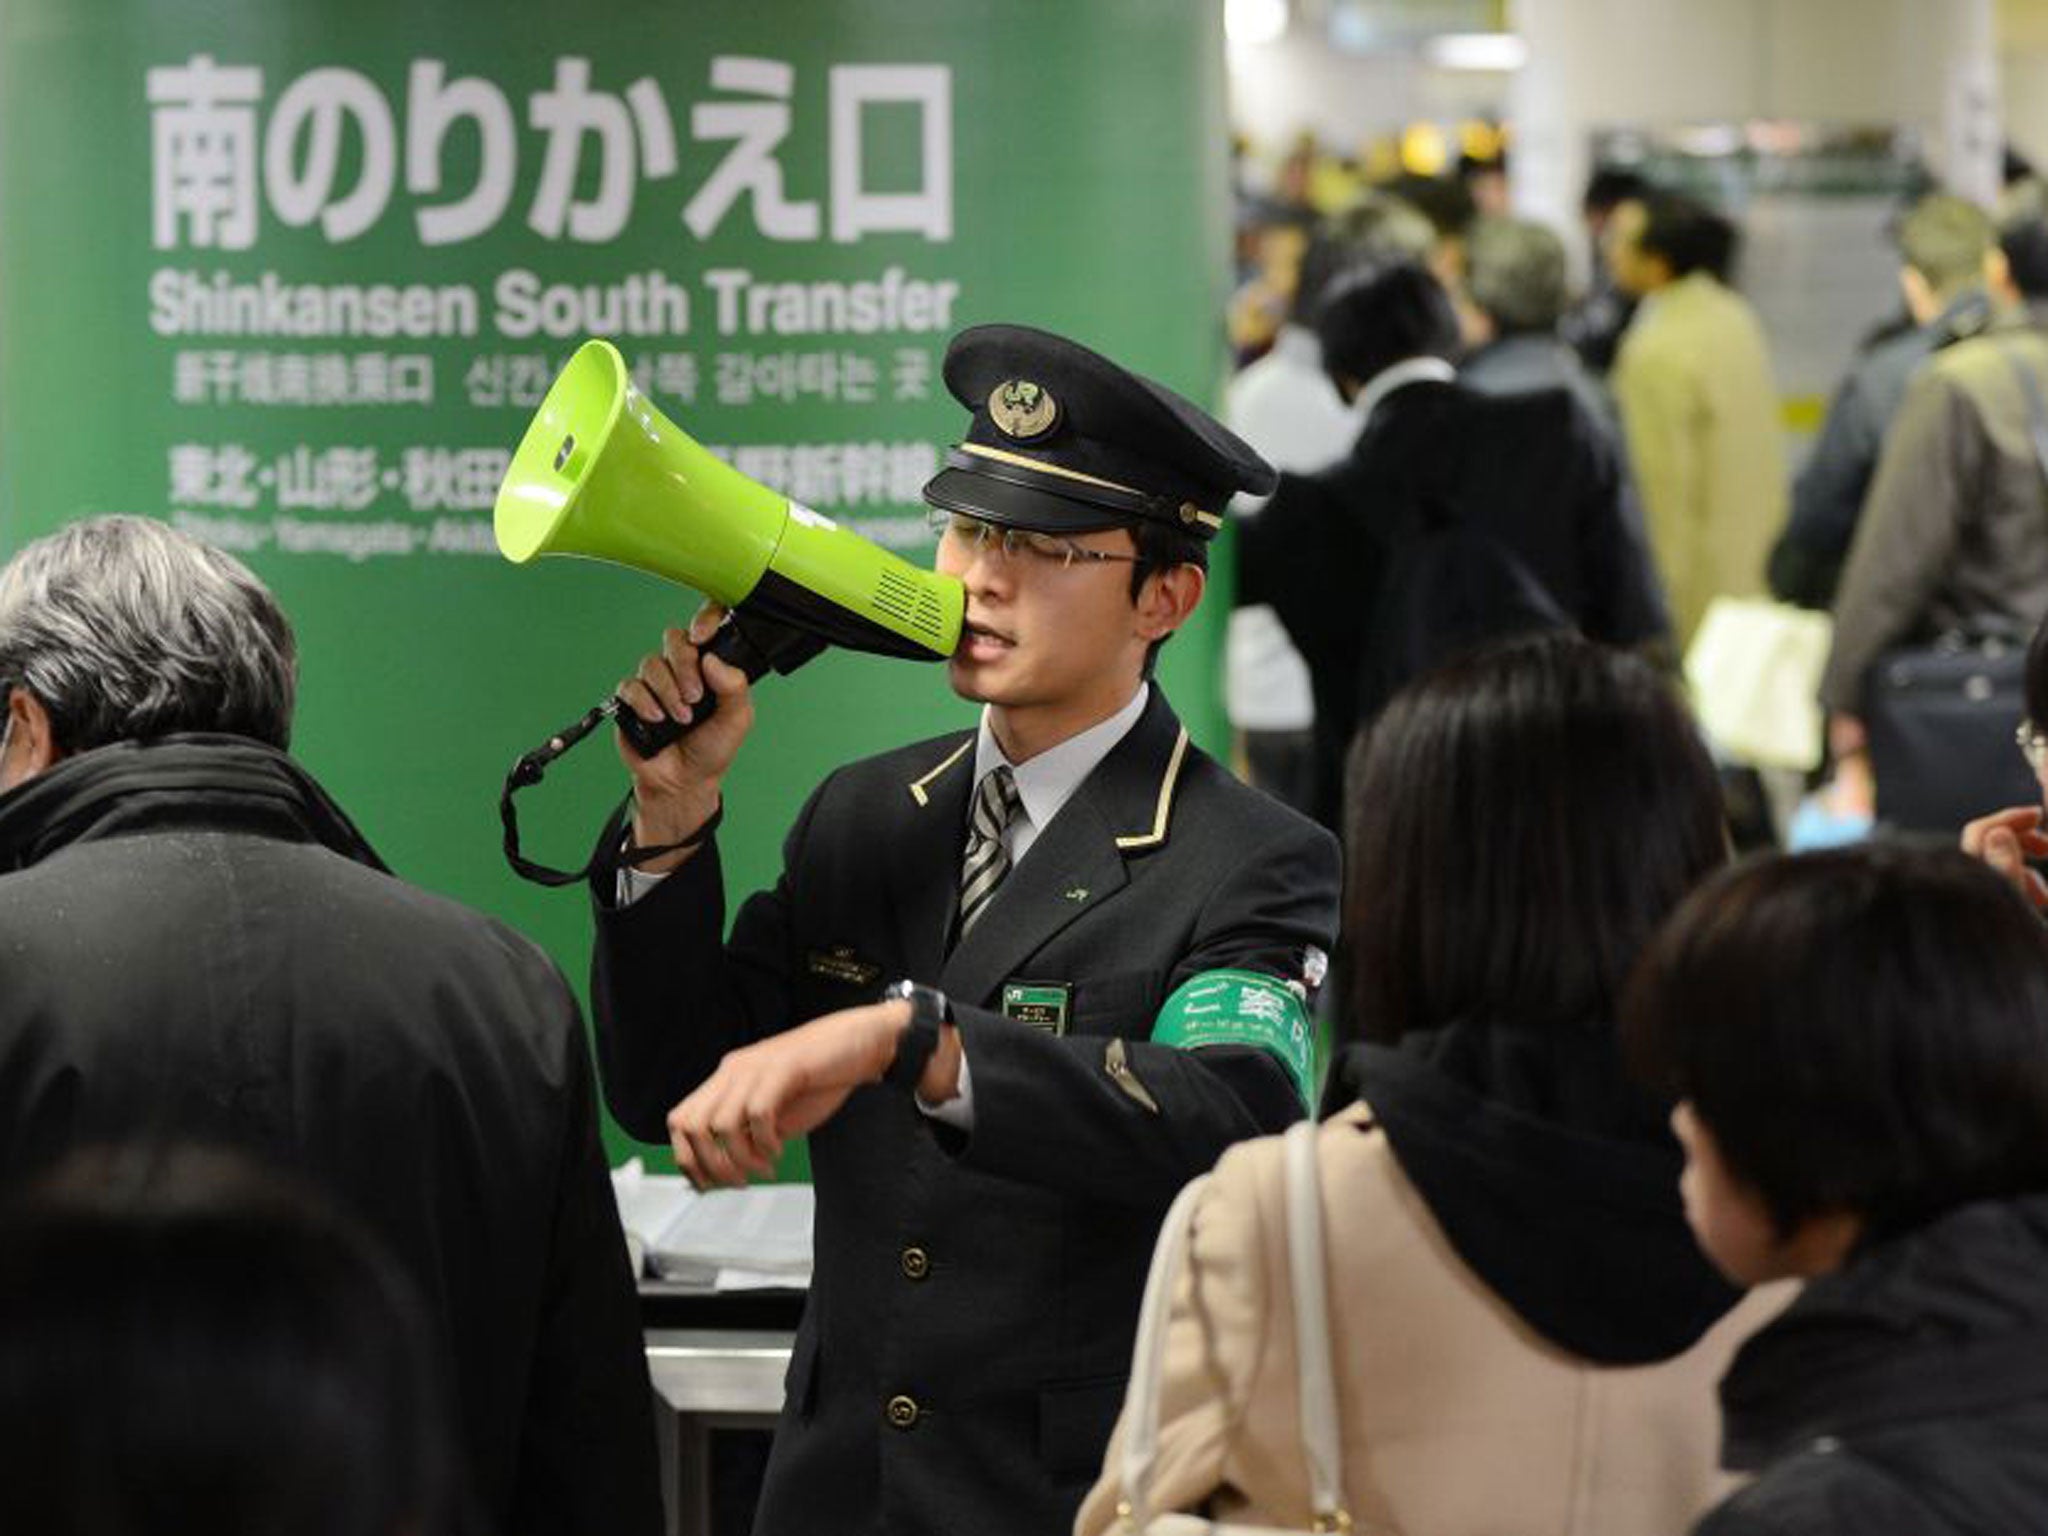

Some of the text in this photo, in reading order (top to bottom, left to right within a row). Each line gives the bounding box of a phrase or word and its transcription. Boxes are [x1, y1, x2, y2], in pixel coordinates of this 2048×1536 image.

[146, 53, 955, 251] 南のりかえ口
[148, 265, 961, 338] Shinkansen South Transfer
